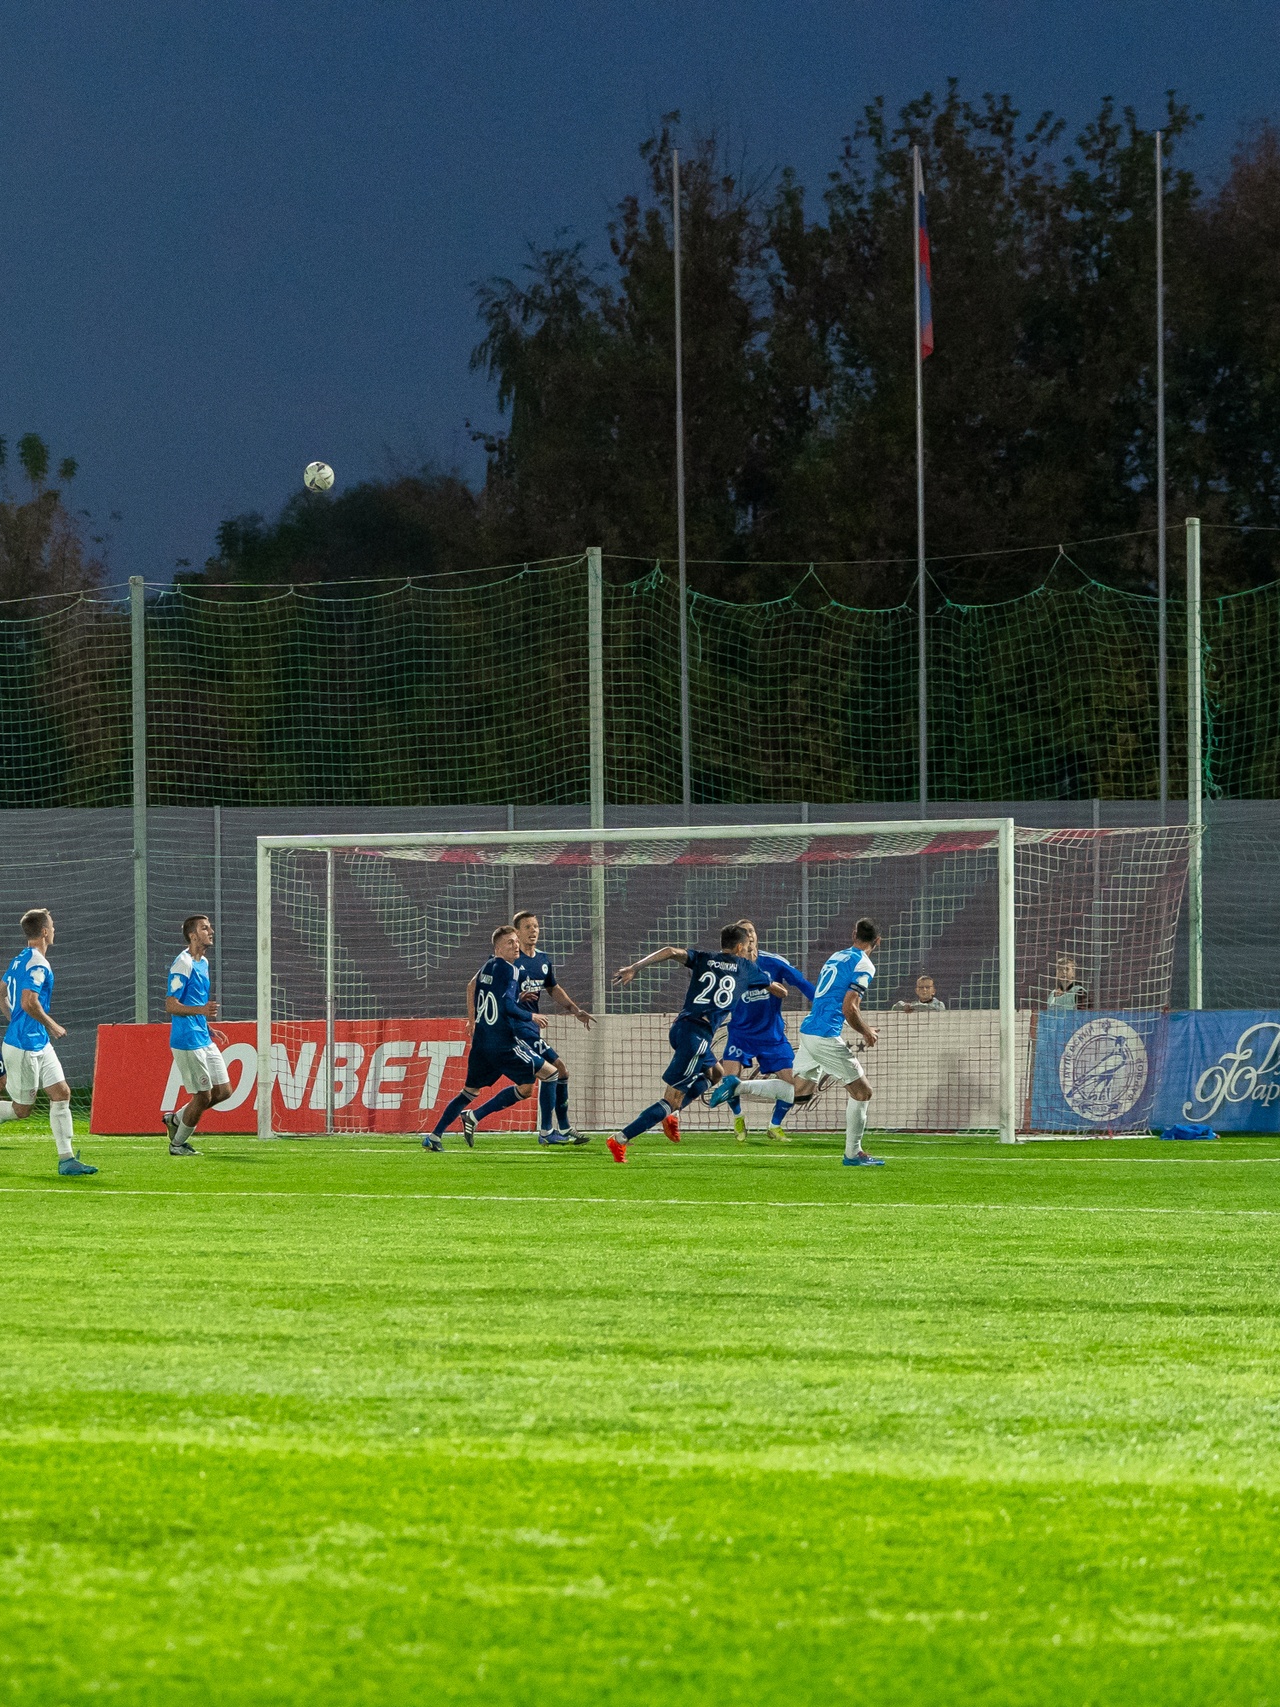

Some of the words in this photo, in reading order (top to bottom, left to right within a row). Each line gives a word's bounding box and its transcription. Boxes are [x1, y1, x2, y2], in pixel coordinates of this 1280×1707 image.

[476, 989, 499, 1026] 90
[693, 971, 736, 1008] 28
[728, 1045, 743, 1058] 99
